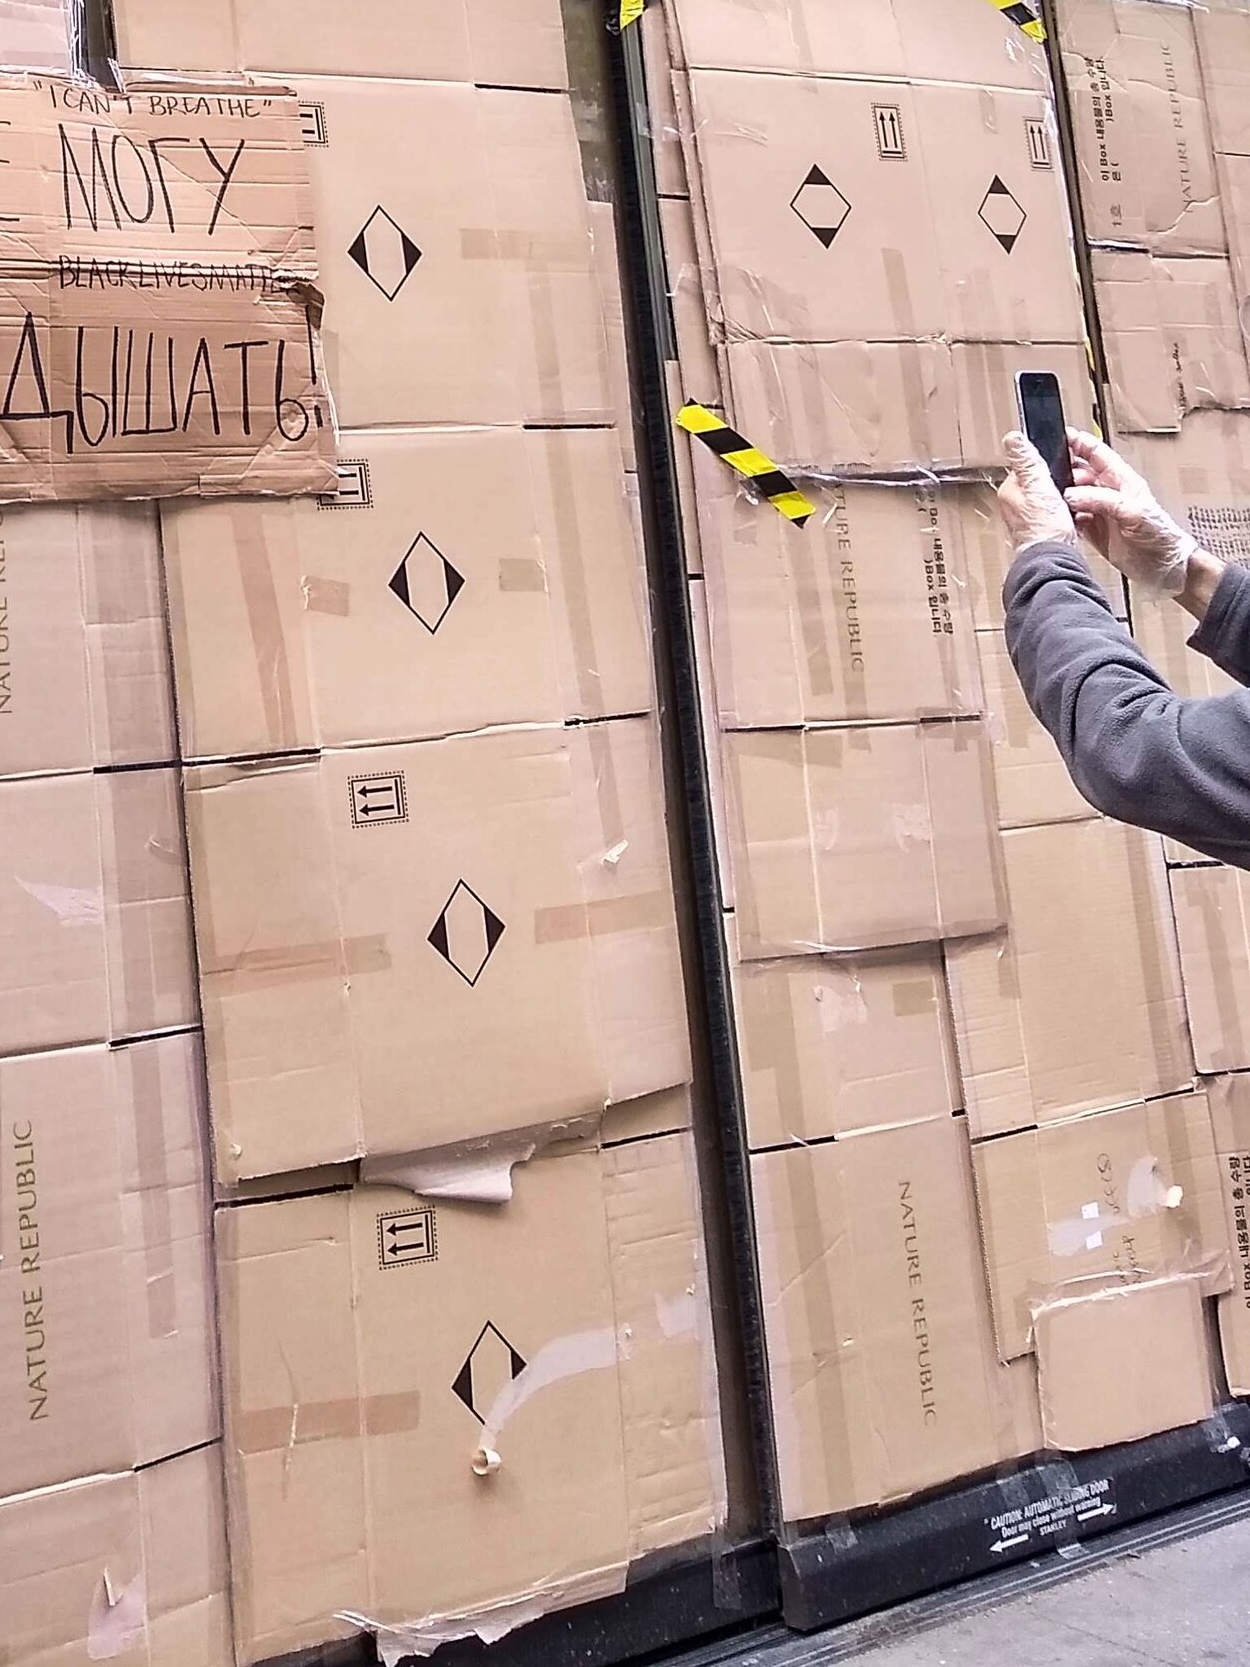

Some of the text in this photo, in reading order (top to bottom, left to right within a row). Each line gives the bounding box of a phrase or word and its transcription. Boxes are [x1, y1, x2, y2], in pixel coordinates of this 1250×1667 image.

[63, 88, 133, 115] CAN'T
[1159, 43, 1184, 129] REPUBLIC
[58, 123, 245, 236] МОГУ
[1099, 144, 1109, 167] Box
[840, 560, 865, 674] REPUBLIC
[11, 1118, 51, 1422] NATURE REPUBLIC
[897, 1181, 939, 1426] NATURE REPUBLIC
[1001, 1524, 1019, 1538] Door
[1032, 1513, 1050, 1528] close
[1050, 1504, 1075, 1522] without
[1024, 1497, 1063, 1517] AUTOMATIC
[1089, 1478, 1110, 1496] DOOR
[1039, 1519, 1067, 1536] STANLEY
